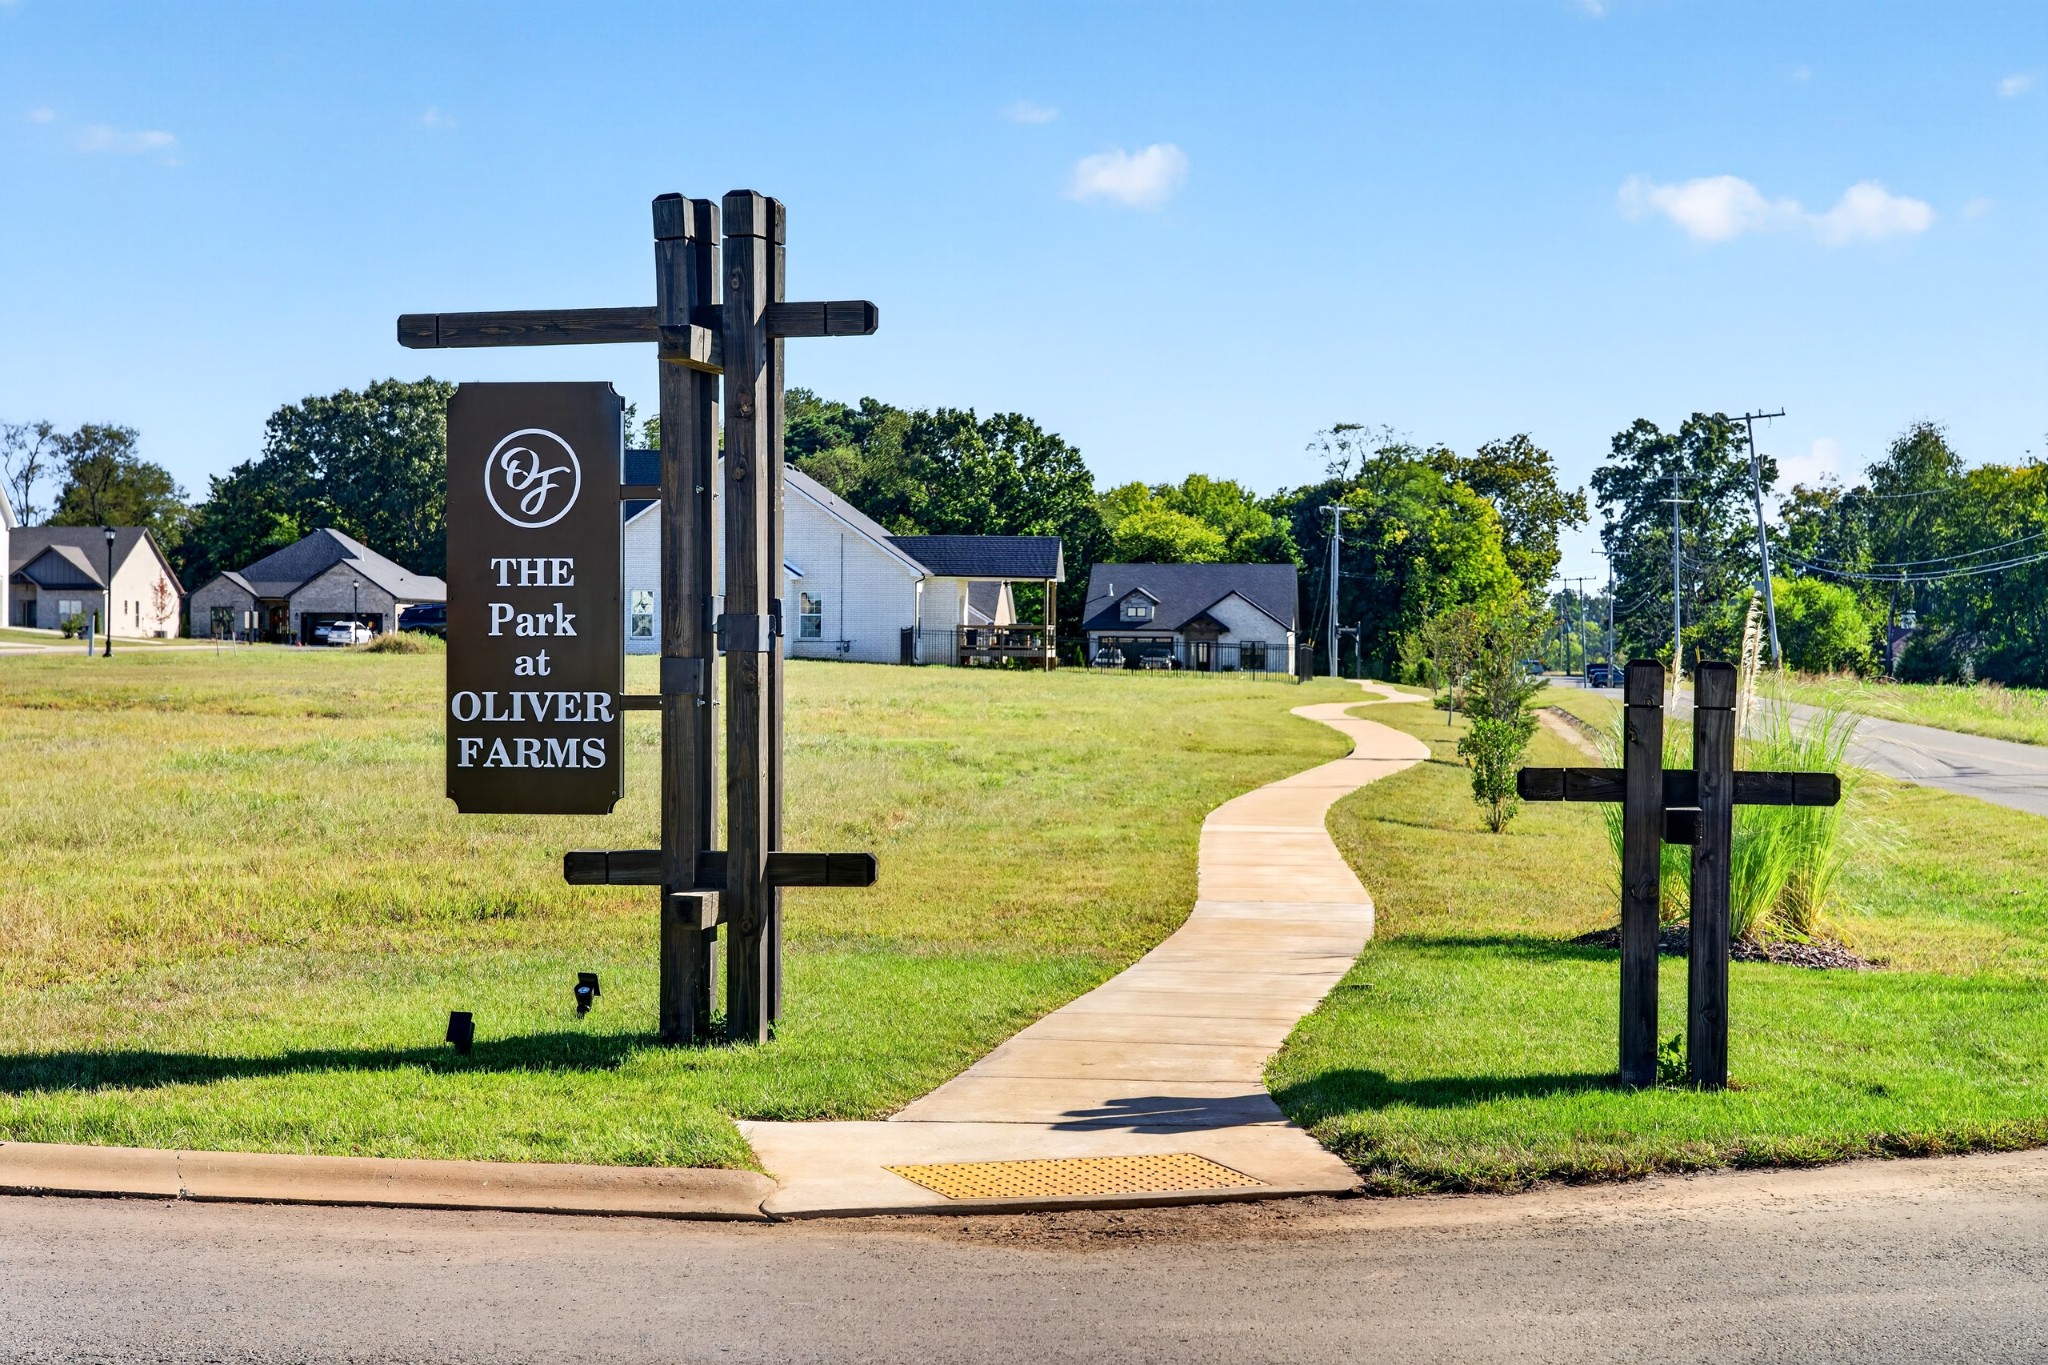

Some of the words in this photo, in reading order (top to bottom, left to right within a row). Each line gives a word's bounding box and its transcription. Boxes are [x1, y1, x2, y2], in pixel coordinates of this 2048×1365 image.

[491, 558, 574, 586] THE
[489, 603, 577, 636] Park
[515, 649, 550, 675] at
[452, 691, 614, 722] OLIVER
[458, 738, 605, 768] FARMS
